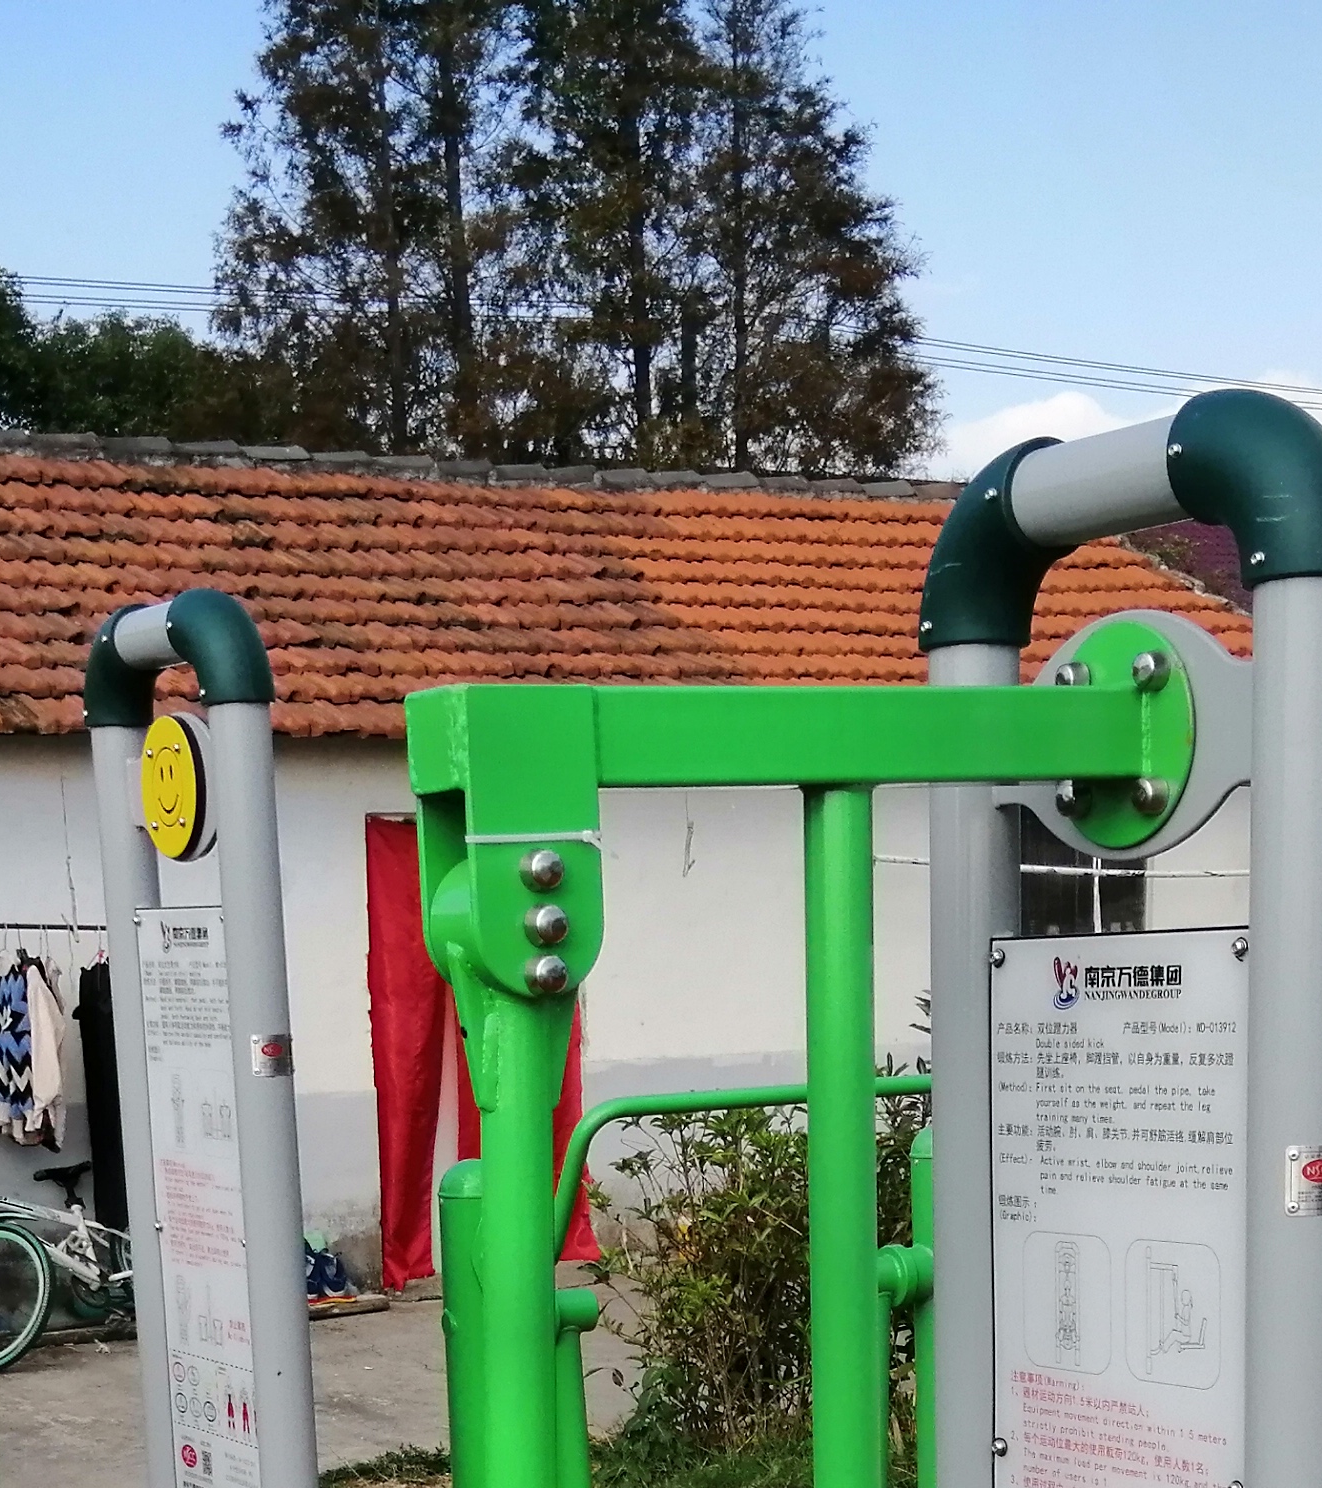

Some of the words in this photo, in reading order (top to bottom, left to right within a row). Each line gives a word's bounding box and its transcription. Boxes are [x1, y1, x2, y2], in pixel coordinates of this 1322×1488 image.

[1084, 964, 1182, 988] 南京万德集团
[1084, 988, 1182, 1001] NANJINGWANDEGROUP
[1035, 1038, 1061, 1049] Double
[1063, 1038, 1085, 1049] sided
[1087, 1038, 1105, 1049] kick
[1035, 1082, 1057, 1094] First
[1059, 1083, 1073, 1094] sit
[1074, 1085, 1085, 1094] on
[1087, 1083, 1101, 1094] the
[1128, 1084, 1150, 1096] pedal
[1154, 1085, 1168, 1096] the
[1197, 1085, 1216, 1097] take
[1035, 1097, 1069, 1109] yourself
[1071, 1100, 1081, 1109] as
[1083, 1098, 1097, 1109] the
[1132, 1099, 1147, 1110] and
[1149, 1101, 1176, 1112] repeat
[1179, 1101, 1194, 1112] the
[1197, 1101, 1212, 1114] leg
[1035, 1113, 1069, 1125] training
[1040, 1154, 1065, 1167] Active
[1095, 1158, 1118, 1169] elbow
[1120, 1160, 1134, 1171] and
[1137, 1160, 1171, 1172] shoulder
[1039, 1171, 1057, 1182] pain
[1059, 1172, 1073, 1182] and
[1075, 1172, 1105, 1184] relieve
[1108, 1173, 1142, 1186] shoulder
[1145, 1175, 1177, 1190] fatigue
[1179, 1178, 1189, 1189] at
[1192, 1178, 1207, 1190] the
[1210, 1181, 1229, 1192] same
[1022, 1402, 1061, 1418] Equipment
[1063, 1410, 1100, 1426] movement
[1102, 1417, 1143, 1431] direction
[1147, 1424, 1176, 1438] within
[1197, 1433, 1228, 1446] meters
[1022, 1419, 1057, 1435] strictly
[1059, 1423, 1096, 1440] prohibit
[1098, 1430, 1135, 1447] standing
[1022, 1447, 1037, 1460] The
[1093, 1461, 1108, 1472] per
[1111, 1466, 1148, 1480] movement
[1152, 1473, 1162, 1482] is
[1022, 1463, 1049, 1476] number
[1051, 1469, 1061, 1480] of
[1064, 1472, 1087, 1484] users
